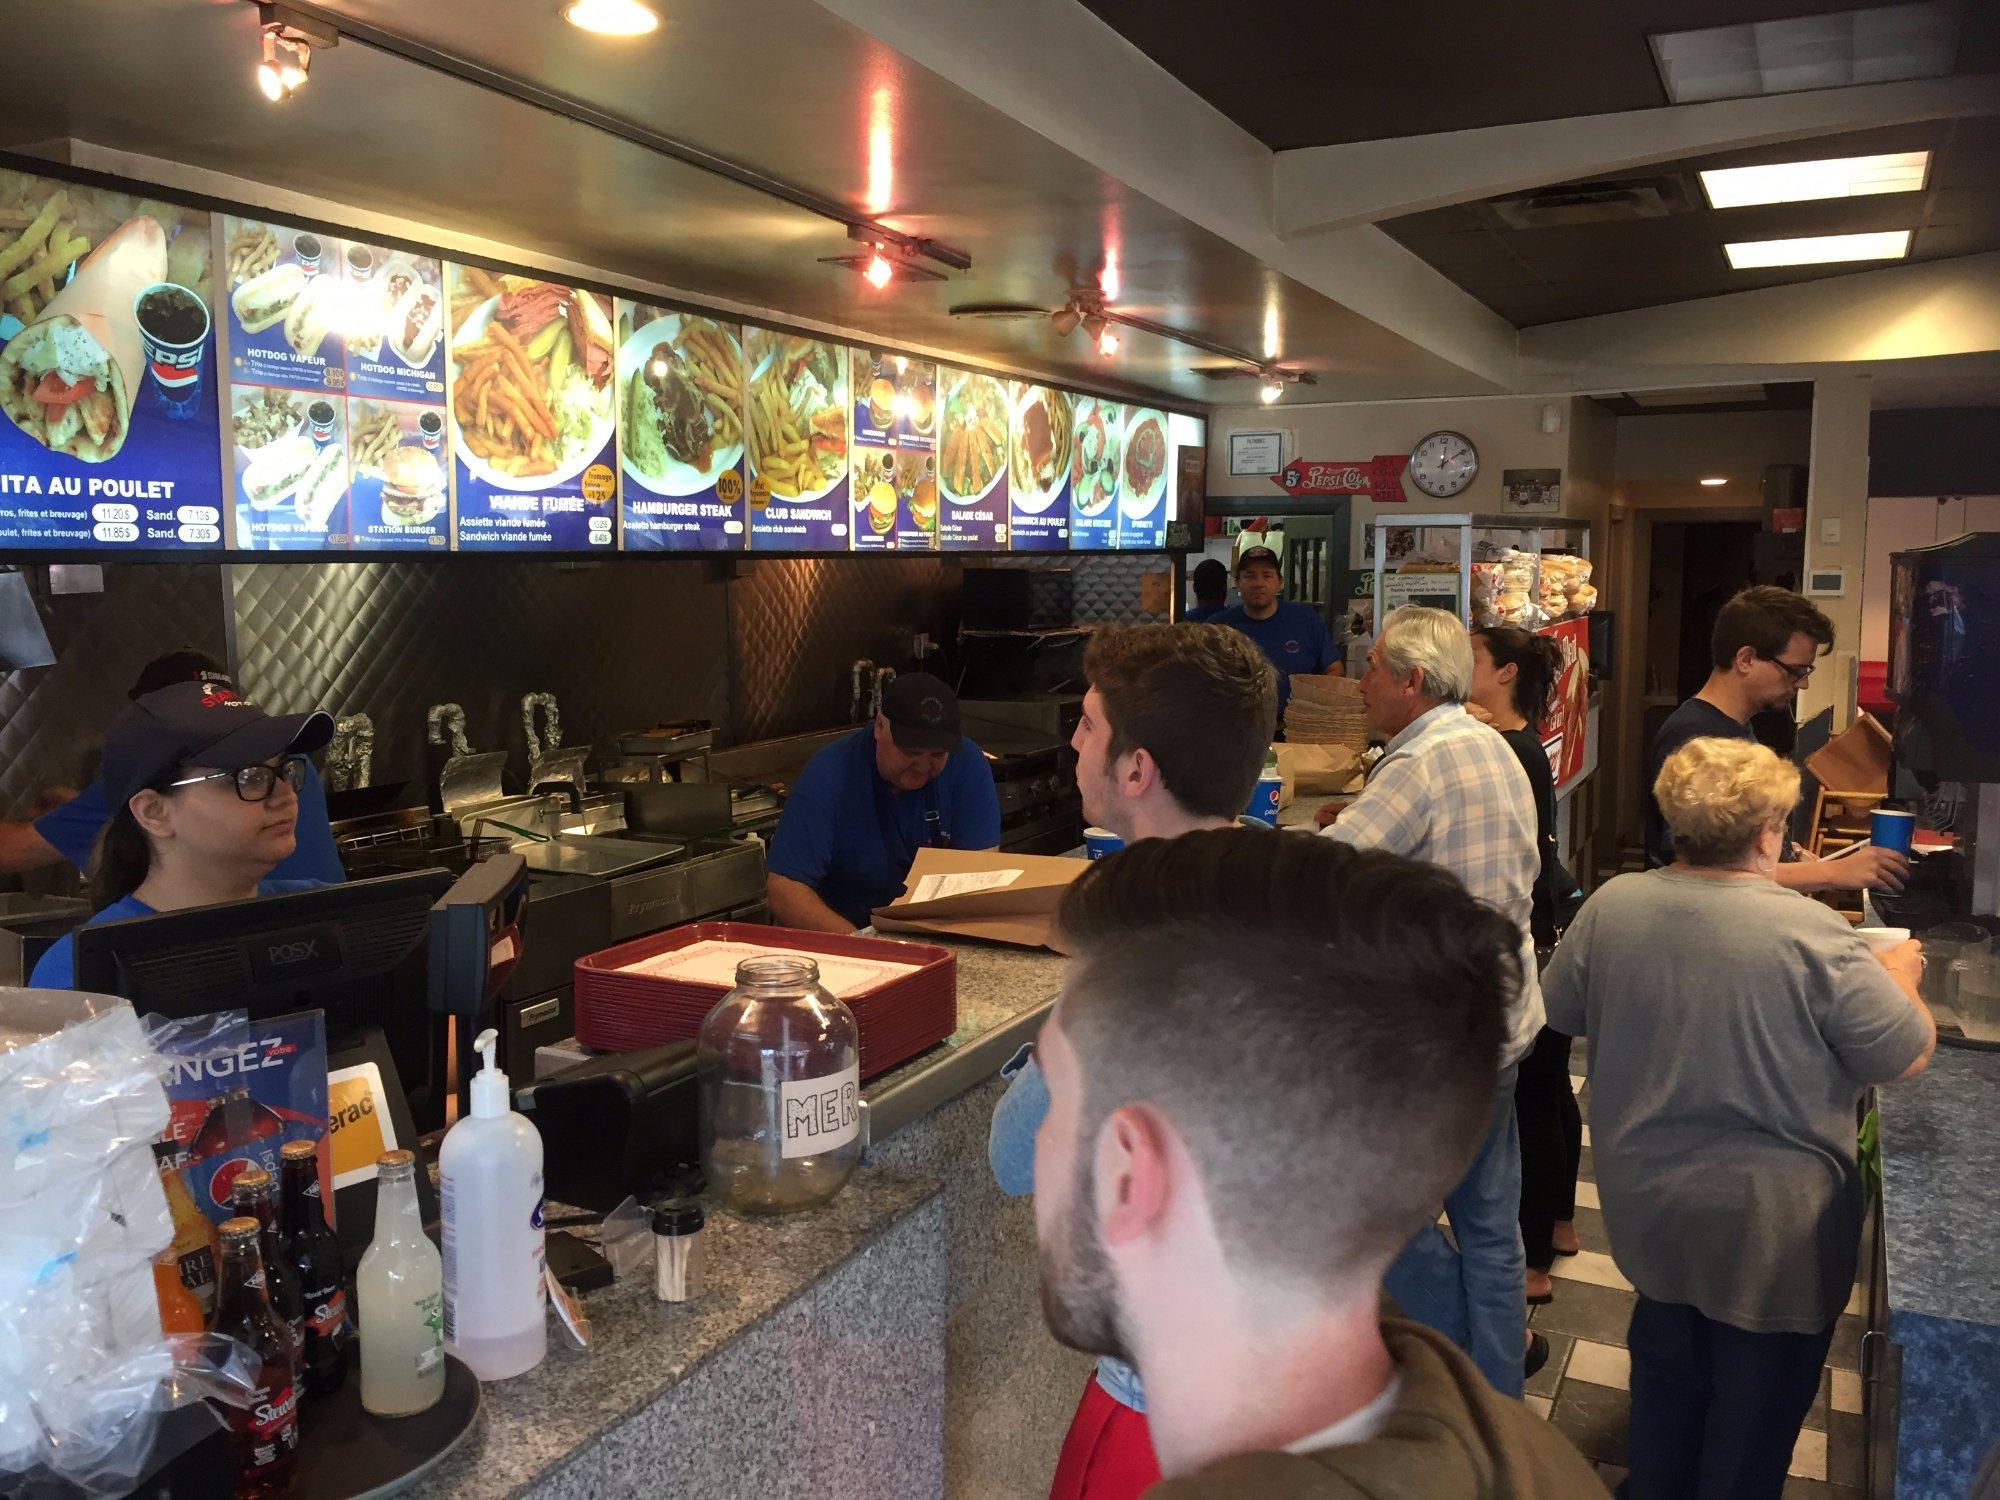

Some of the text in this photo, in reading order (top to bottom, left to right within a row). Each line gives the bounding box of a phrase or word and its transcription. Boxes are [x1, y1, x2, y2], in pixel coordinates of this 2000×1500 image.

[247, 348, 326, 366] HOTDOG VAPEUR
[360, 362, 436, 380] HOTDOG MICHIGAN
[48, 476, 81, 496] AU
[88, 478, 175, 499] POULET
[718, 477, 740, 494] 100%
[0, 508, 88, 520] ros, frites et breuvage)
[146, 509, 176, 521] Sand.
[632, 501, 732, 517] HAMBURGER STEAK
[765, 506, 788, 519] CLUB
[459, 516, 547, 528] Assiette viande fumée
[623, 520, 700, 532] Assiette hamburger steak
[21, 528, 42, 537] frites
[43, 529, 52, 537] et
[53, 529, 91, 540] breuvage)
[147, 527, 177, 539] Sand.
[368, 525, 437, 534] STATION BURGER
[752, 524, 772, 533] Assiette
[459, 530, 552, 542] Sandwich viande fumée
[268, 1046, 292, 1056] votre
[786, 1081, 858, 1139] MER
